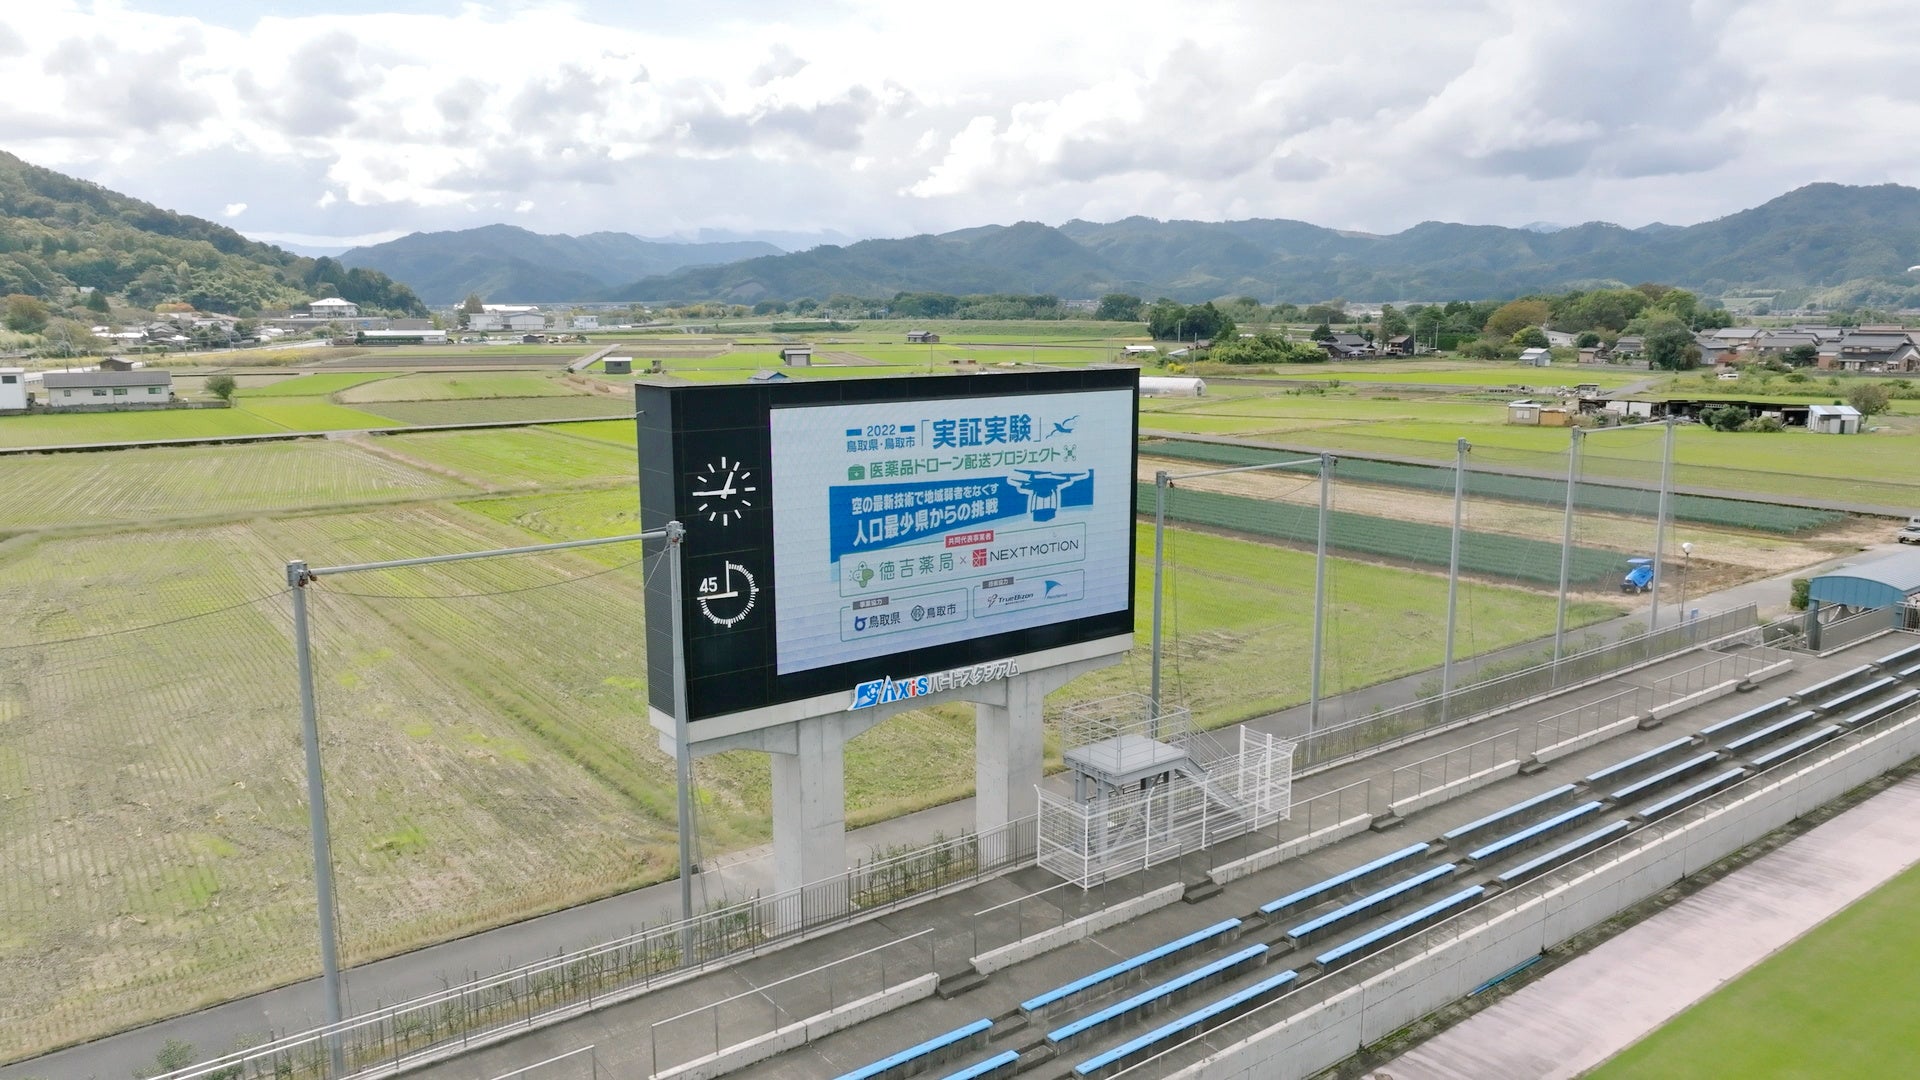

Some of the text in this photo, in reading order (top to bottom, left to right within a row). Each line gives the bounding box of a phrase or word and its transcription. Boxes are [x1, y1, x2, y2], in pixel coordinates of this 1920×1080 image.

[867, 424, 896, 437] 2022
[920, 414, 1042, 450] 「実証実験」
[846, 436, 916, 453] 鳥取県・鳥取市
[870, 447, 1061, 479] 医薬品ドローン配送プロジェクト
[851, 482, 999, 516] 空の最新技術で地域弱者をなくす
[853, 500, 999, 547] 人口最少県からの挑戦
[879, 552, 954, 581] 徳吉薬局
[990, 546, 1028, 562] NEXT
[1030, 539, 1079, 556] MOTION
[699, 576, 718, 593] 45
[869, 611, 901, 629] 鳥取県
[926, 603, 957, 619] 鳥取市
